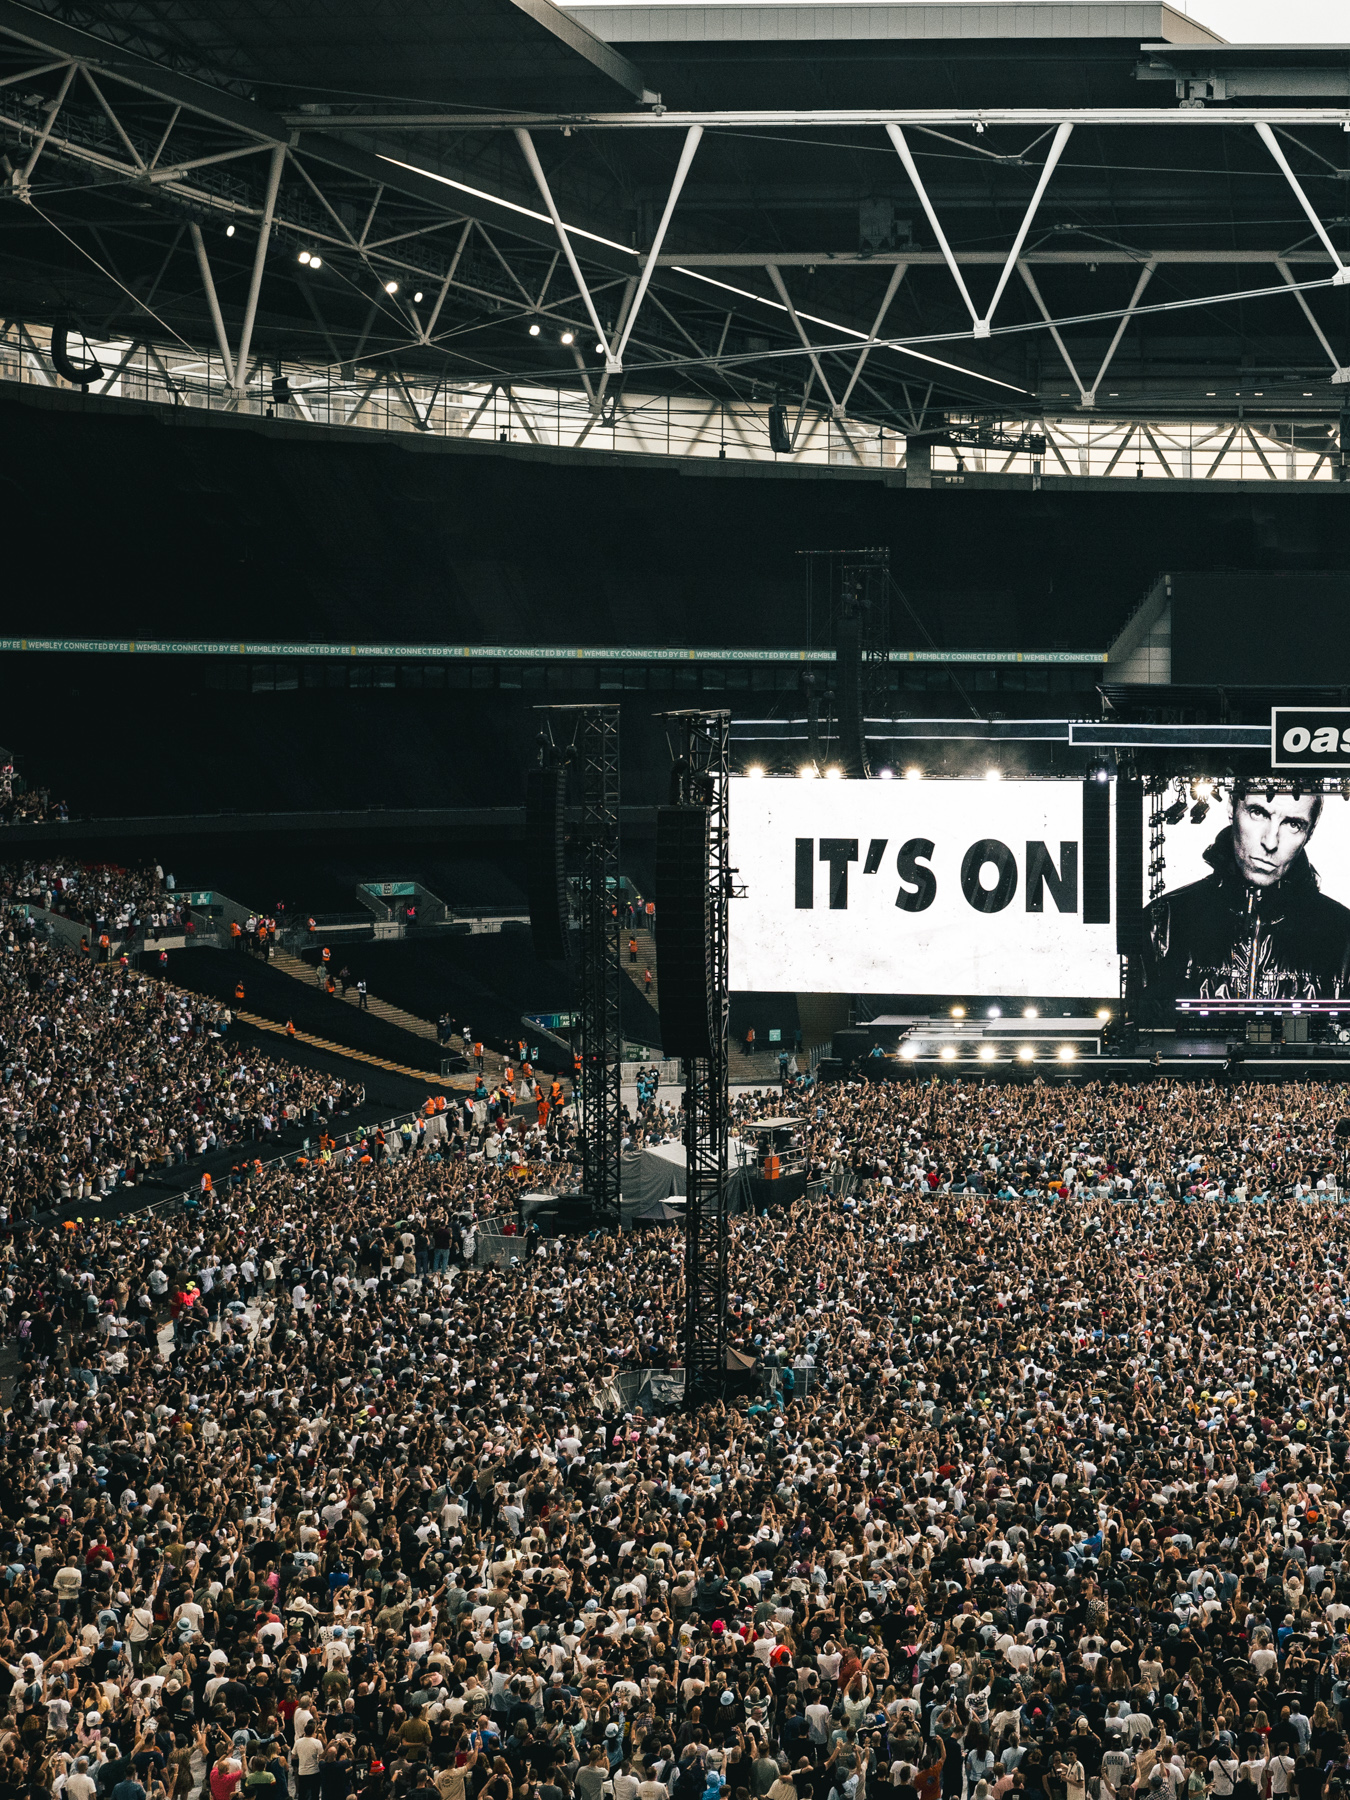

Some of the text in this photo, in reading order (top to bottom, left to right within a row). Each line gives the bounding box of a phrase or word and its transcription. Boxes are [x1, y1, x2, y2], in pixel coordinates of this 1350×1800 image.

[13, 641, 21, 649] EE
[28, 641, 63, 649] WEMBLEY
[64, 642, 108, 650] CONNECTED
[120, 643, 128, 651] EE
[137, 643, 171, 651] WEMBLEY
[172, 644, 218, 652] CONNECTED
[247, 645, 281, 653] WEMBLEY
[283, 646, 329, 654] CONNECTED
[331, 646, 340, 654] BY
[358, 647, 463, 656] WEMBLEY CONNECTED BY EE
[472, 648, 507, 656] WEMBLEY
[509, 649, 555, 657] CONNECTED
[585, 650, 620, 658] WEMBLEY
[621, 650, 668, 658] CONNECTED
[680, 651, 688, 659] EE
[697, 651, 731, 659] WEMBLEY
[780, 652, 789, 660] BY
[790, 652, 799, 660] EE
[807, 652, 836, 660] WEMBLE
[900, 653, 907, 661] EE
[915, 653, 950, 661] WEMBLEY
[952, 653, 996, 661] CONNECTED
[1059, 654, 1103, 662] CONNECTED
[795, 838, 937, 912] IT'S
